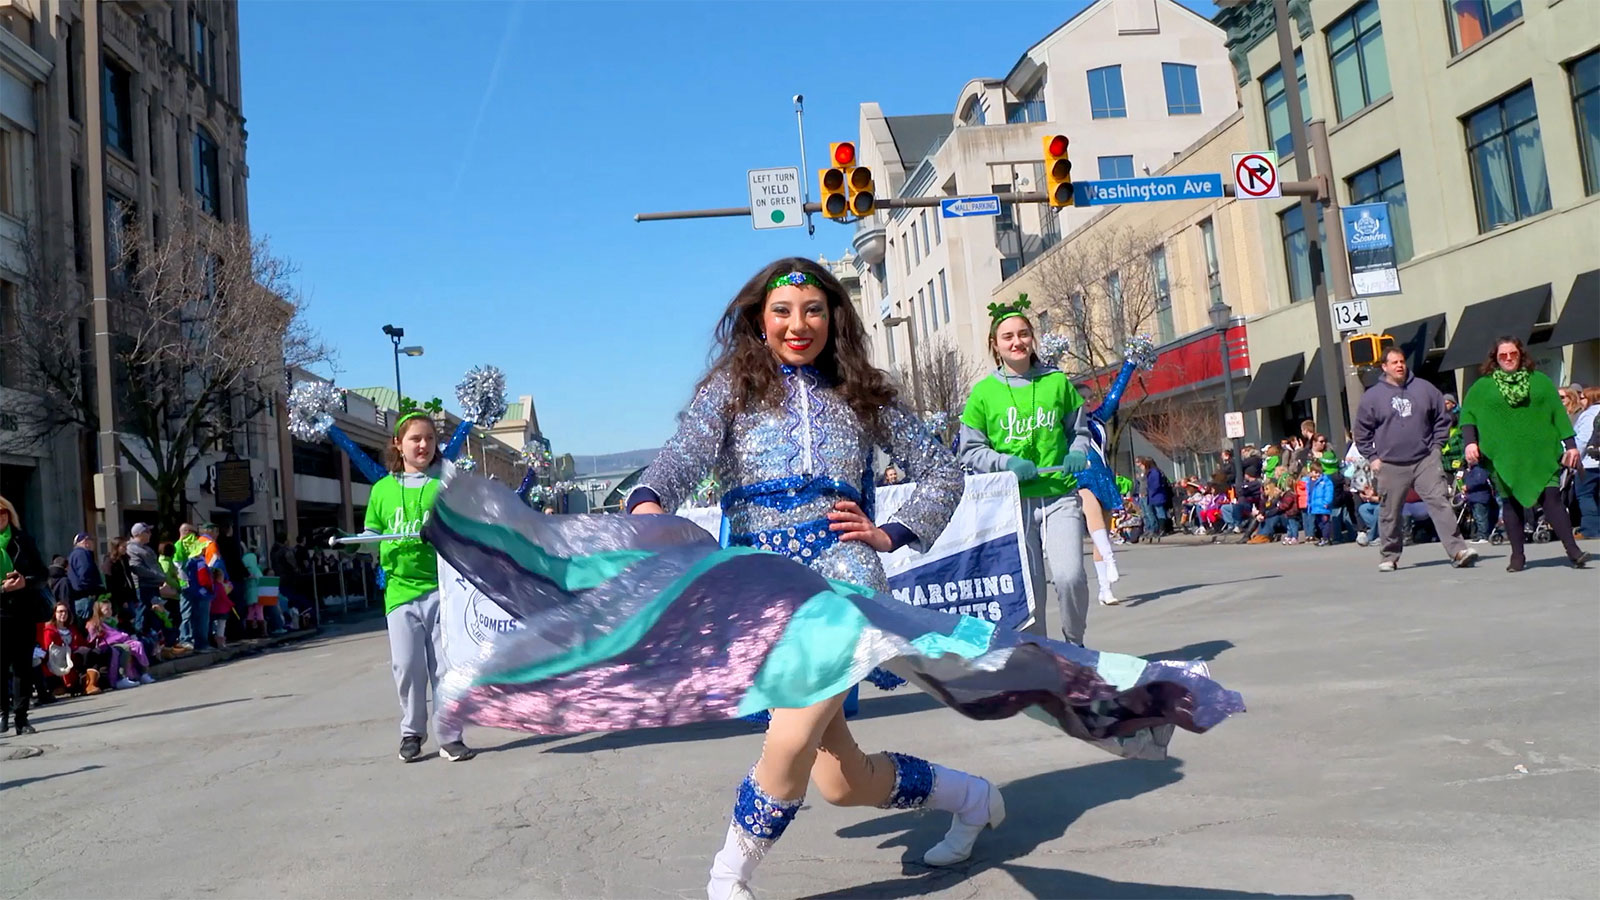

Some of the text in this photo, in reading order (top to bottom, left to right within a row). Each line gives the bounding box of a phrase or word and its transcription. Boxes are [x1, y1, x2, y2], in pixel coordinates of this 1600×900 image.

[753, 173, 795, 184] LEFT TURN
[762, 184, 789, 195] YIELD
[1084, 179, 1212, 201] Washington Ave
[756, 196, 797, 207] ON GREEN
[954, 201, 996, 211] MALL PARKING
[1335, 302, 1363, 324] 13 FT
[1000, 406, 1056, 444] Lucky
[891, 574, 1015, 606] MARCHING
[479, 613, 517, 633] COMETS
